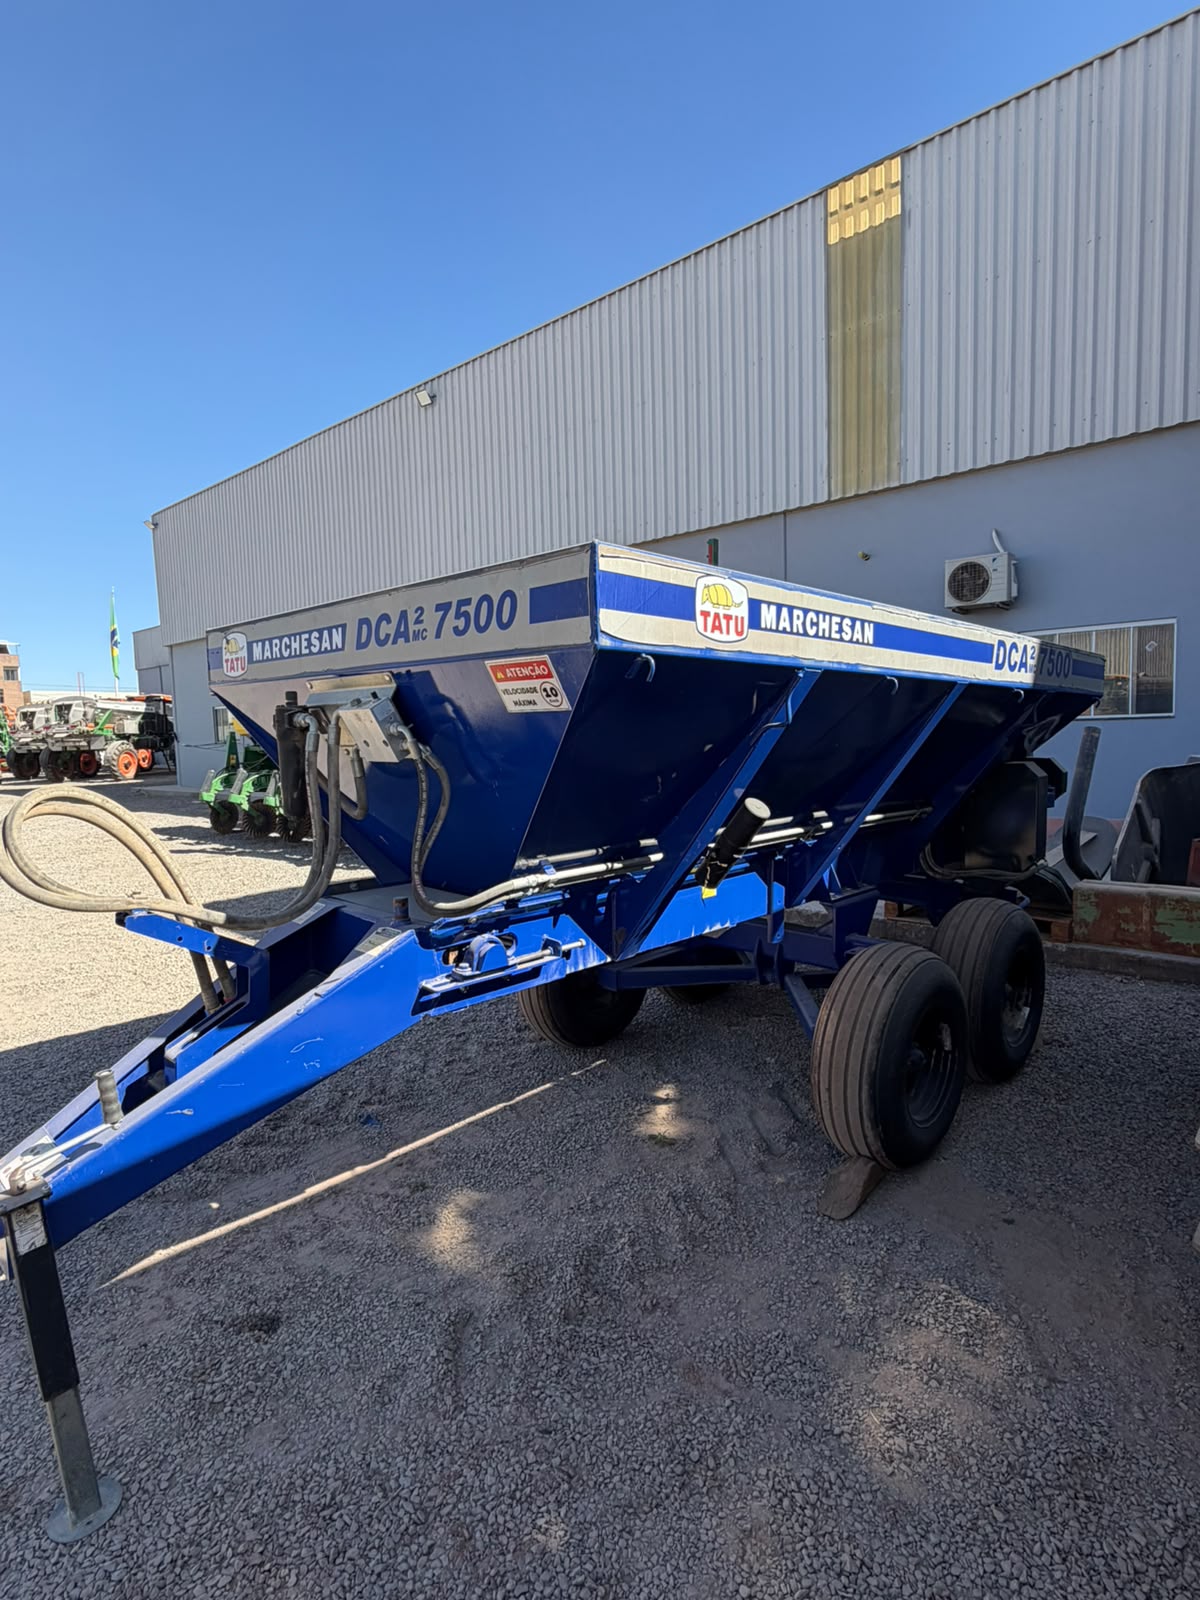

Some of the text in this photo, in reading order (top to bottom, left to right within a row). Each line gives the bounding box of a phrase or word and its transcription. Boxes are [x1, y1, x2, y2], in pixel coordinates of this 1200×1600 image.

[412, 628, 428, 641] MC
[434, 589, 518, 640] 7500
[700, 610, 745, 637] TATU
[760, 603, 874, 645] MARCHESAN
[252, 627, 342, 661] MARCHESAN
[224, 656, 246, 673] TATU
[505, 664, 549, 678] ATENÇÃO
[1039, 647, 1071, 678] 7500
[501, 686, 538, 696] VELOCIDADE
[543, 686, 559, 698] 10
[513, 698, 538, 707] MÁXIMA
